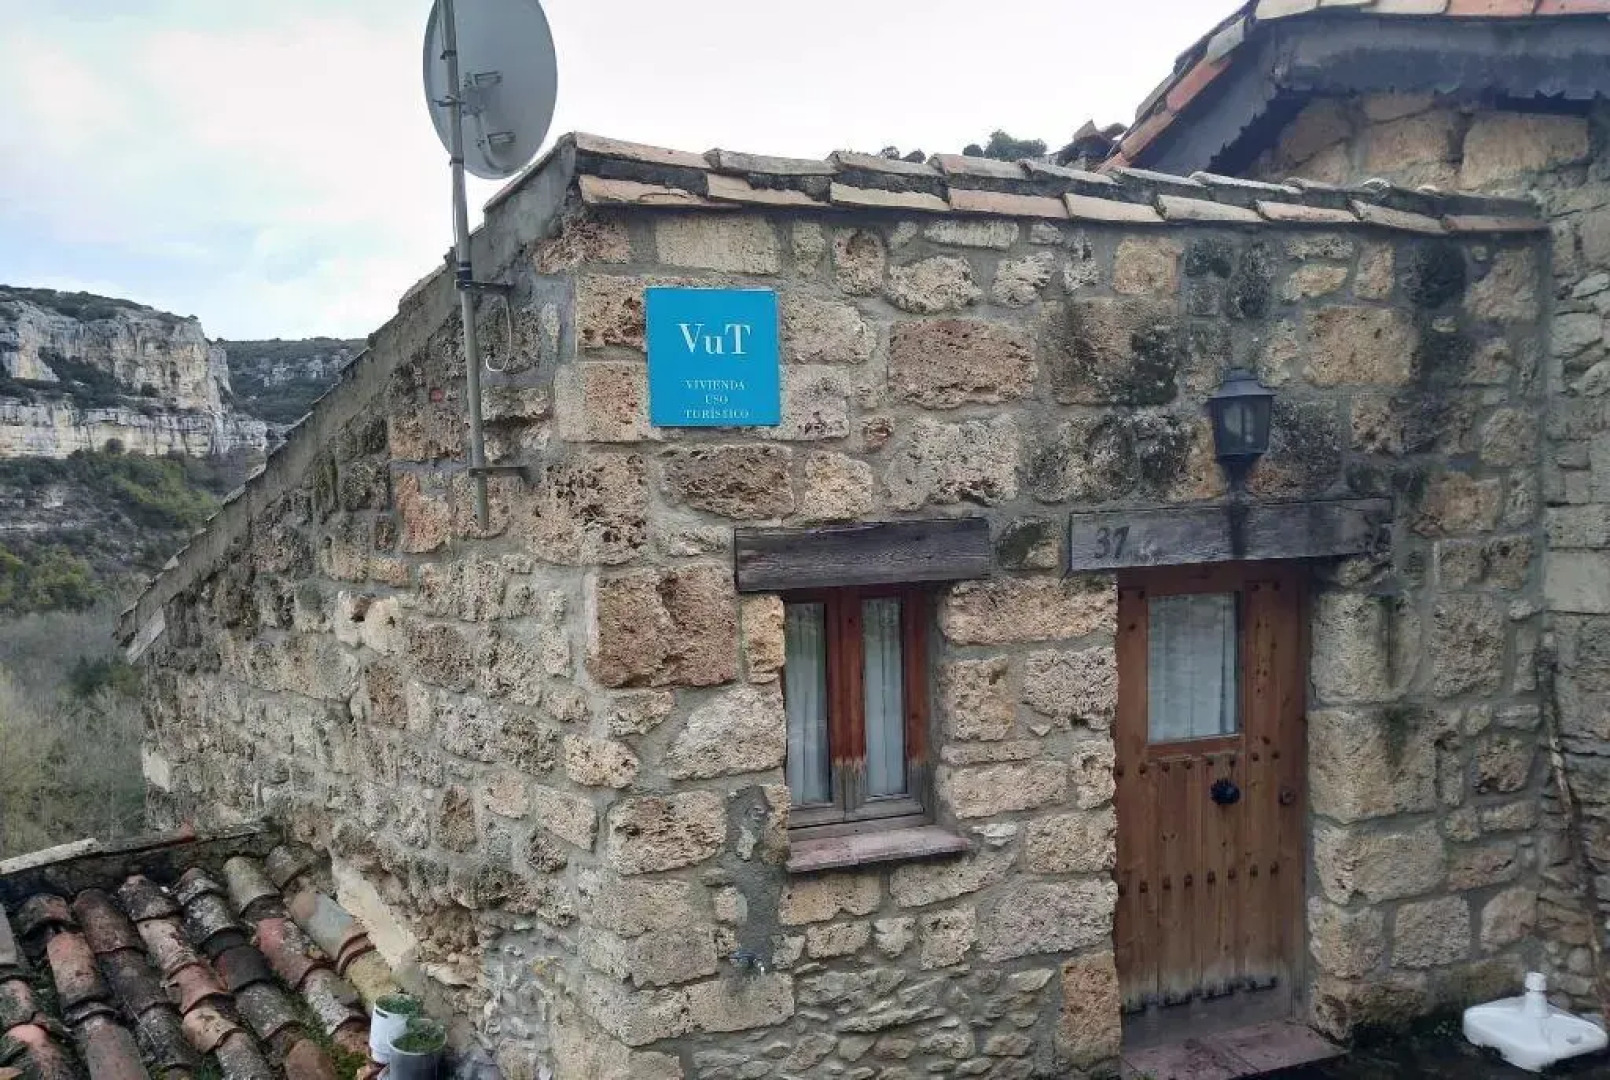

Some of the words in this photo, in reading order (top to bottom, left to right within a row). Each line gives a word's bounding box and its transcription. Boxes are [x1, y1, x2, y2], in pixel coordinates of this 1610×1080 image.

[677, 322, 752, 355] VuT
[685, 379, 745, 391] VIVIENDA
[705, 394, 729, 405] USO
[1094, 525, 1130, 559] 37
